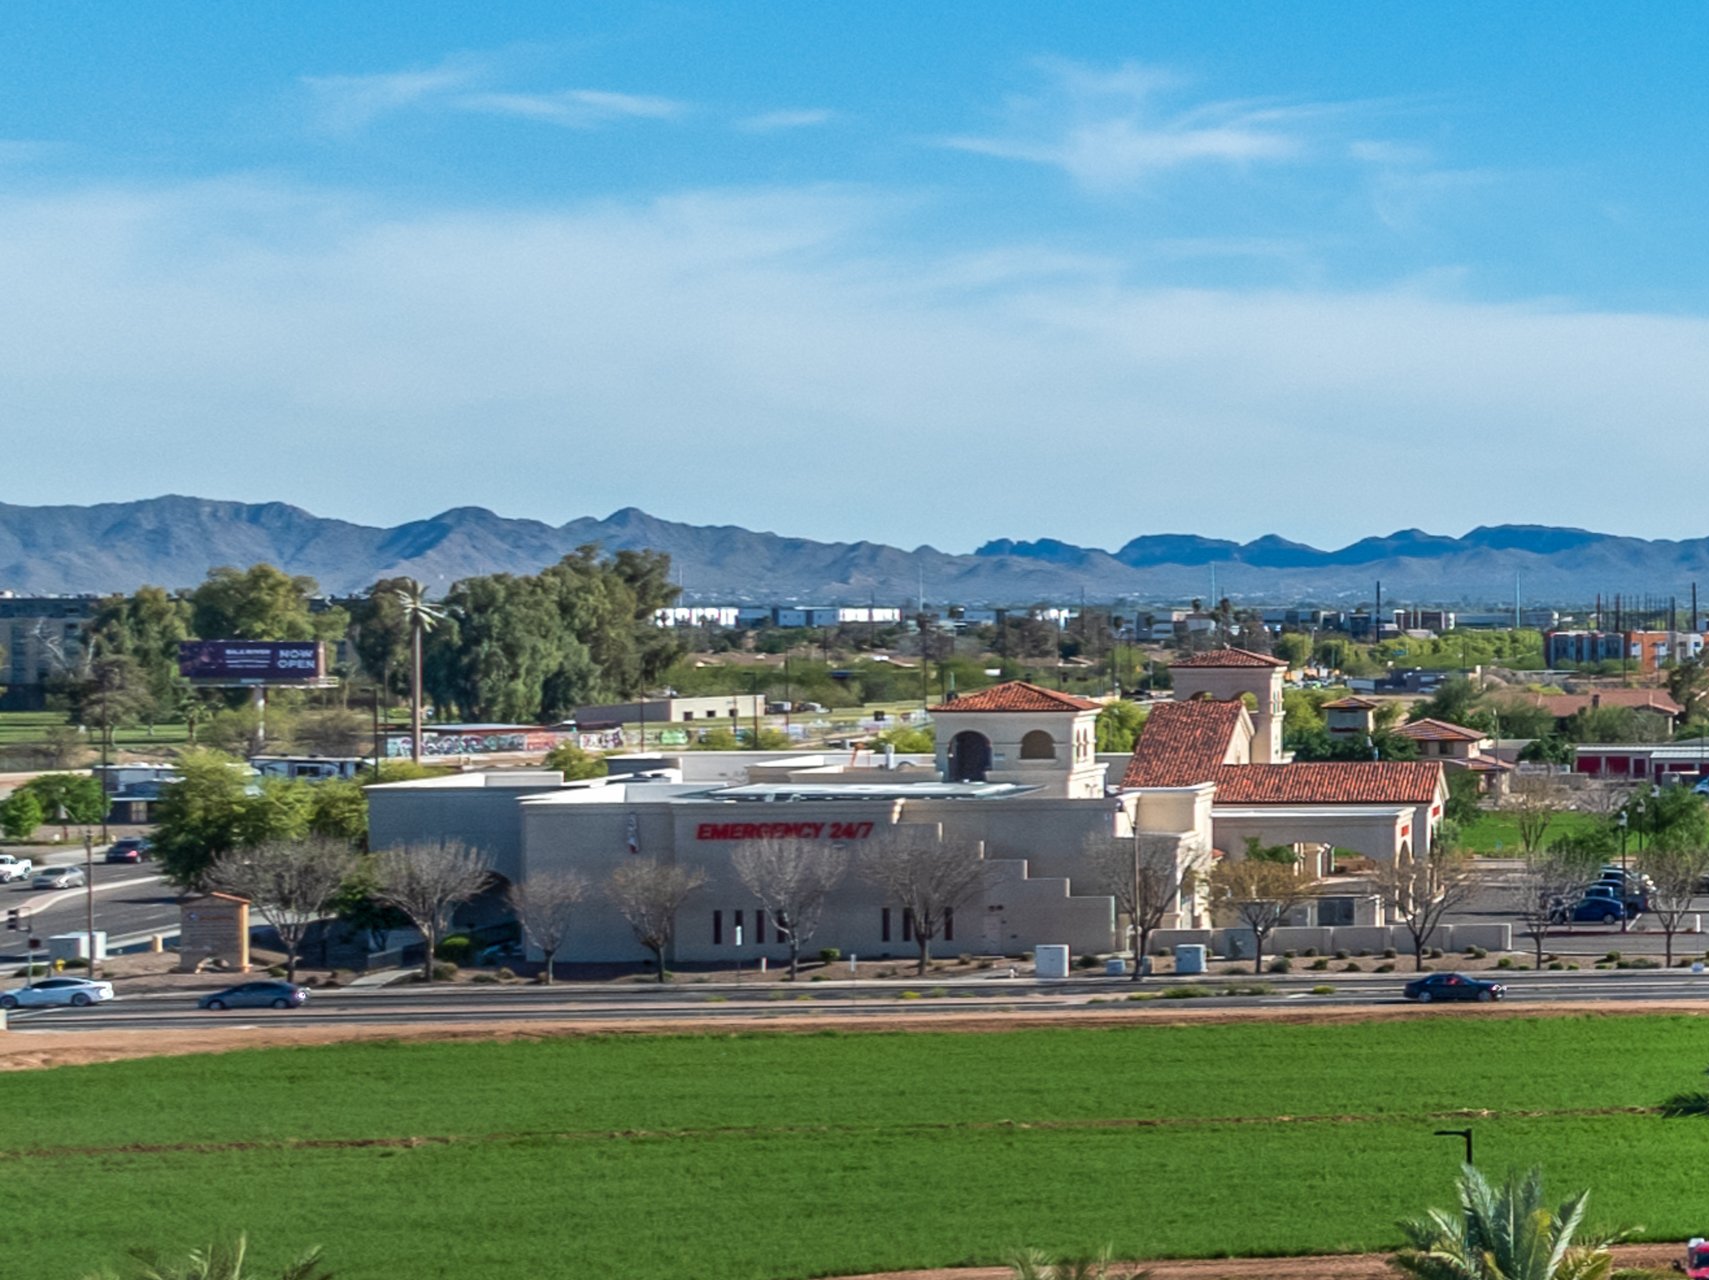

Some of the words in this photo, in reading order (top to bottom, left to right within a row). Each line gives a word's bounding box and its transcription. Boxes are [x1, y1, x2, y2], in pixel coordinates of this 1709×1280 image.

[279, 649, 313, 658] NOW
[277, 659, 315, 669] OPEN
[696, 822, 825, 840] EMERGENCY
[828, 821, 874, 840] 24/7
